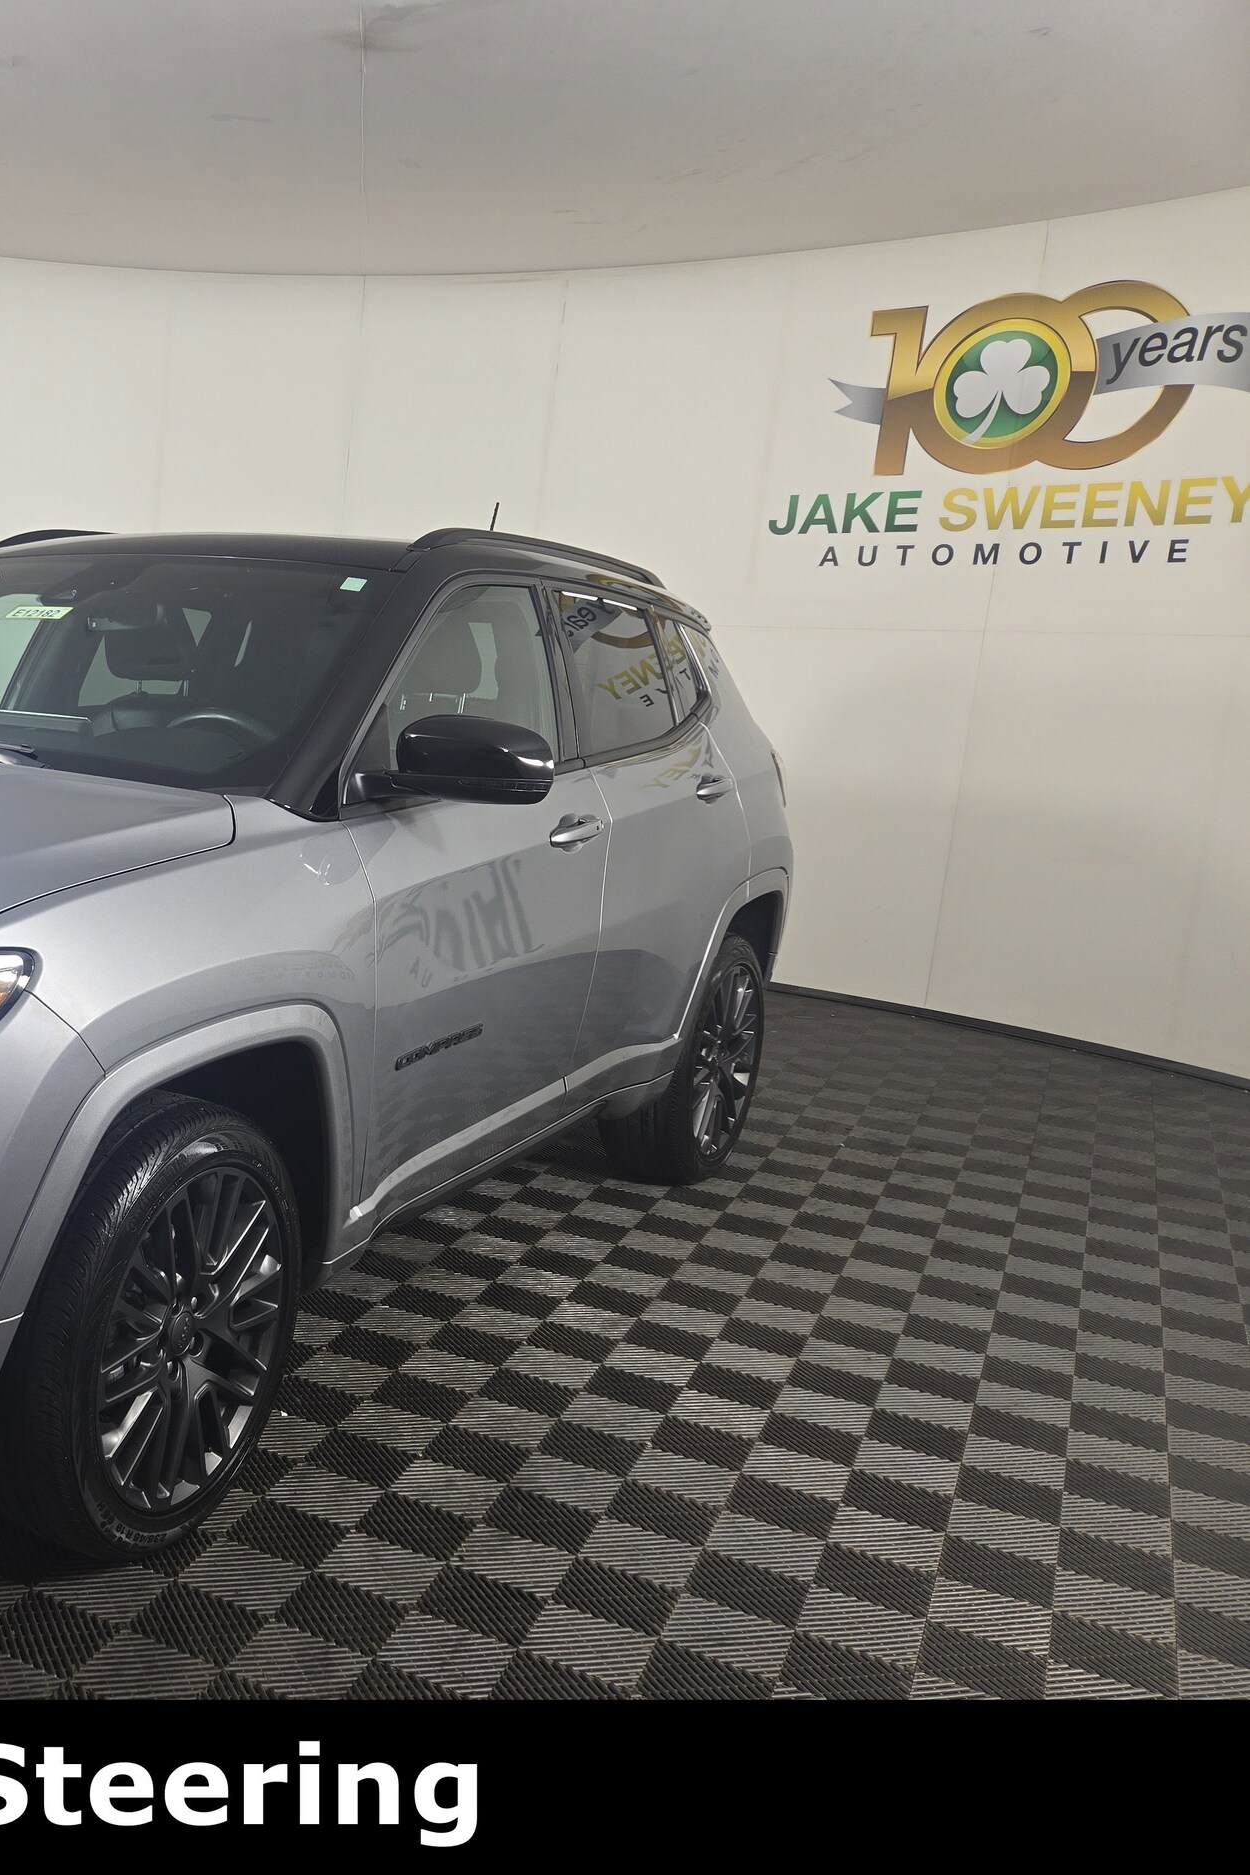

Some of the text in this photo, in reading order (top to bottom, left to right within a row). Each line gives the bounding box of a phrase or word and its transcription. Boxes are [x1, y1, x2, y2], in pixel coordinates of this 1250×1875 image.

[869, 279, 1196, 476] 100
[1105, 323, 1248, 385] years
[768, 475, 1250, 536] JAKE SWEENEY
[818, 538, 1191, 567] AUTOMOTIVE
